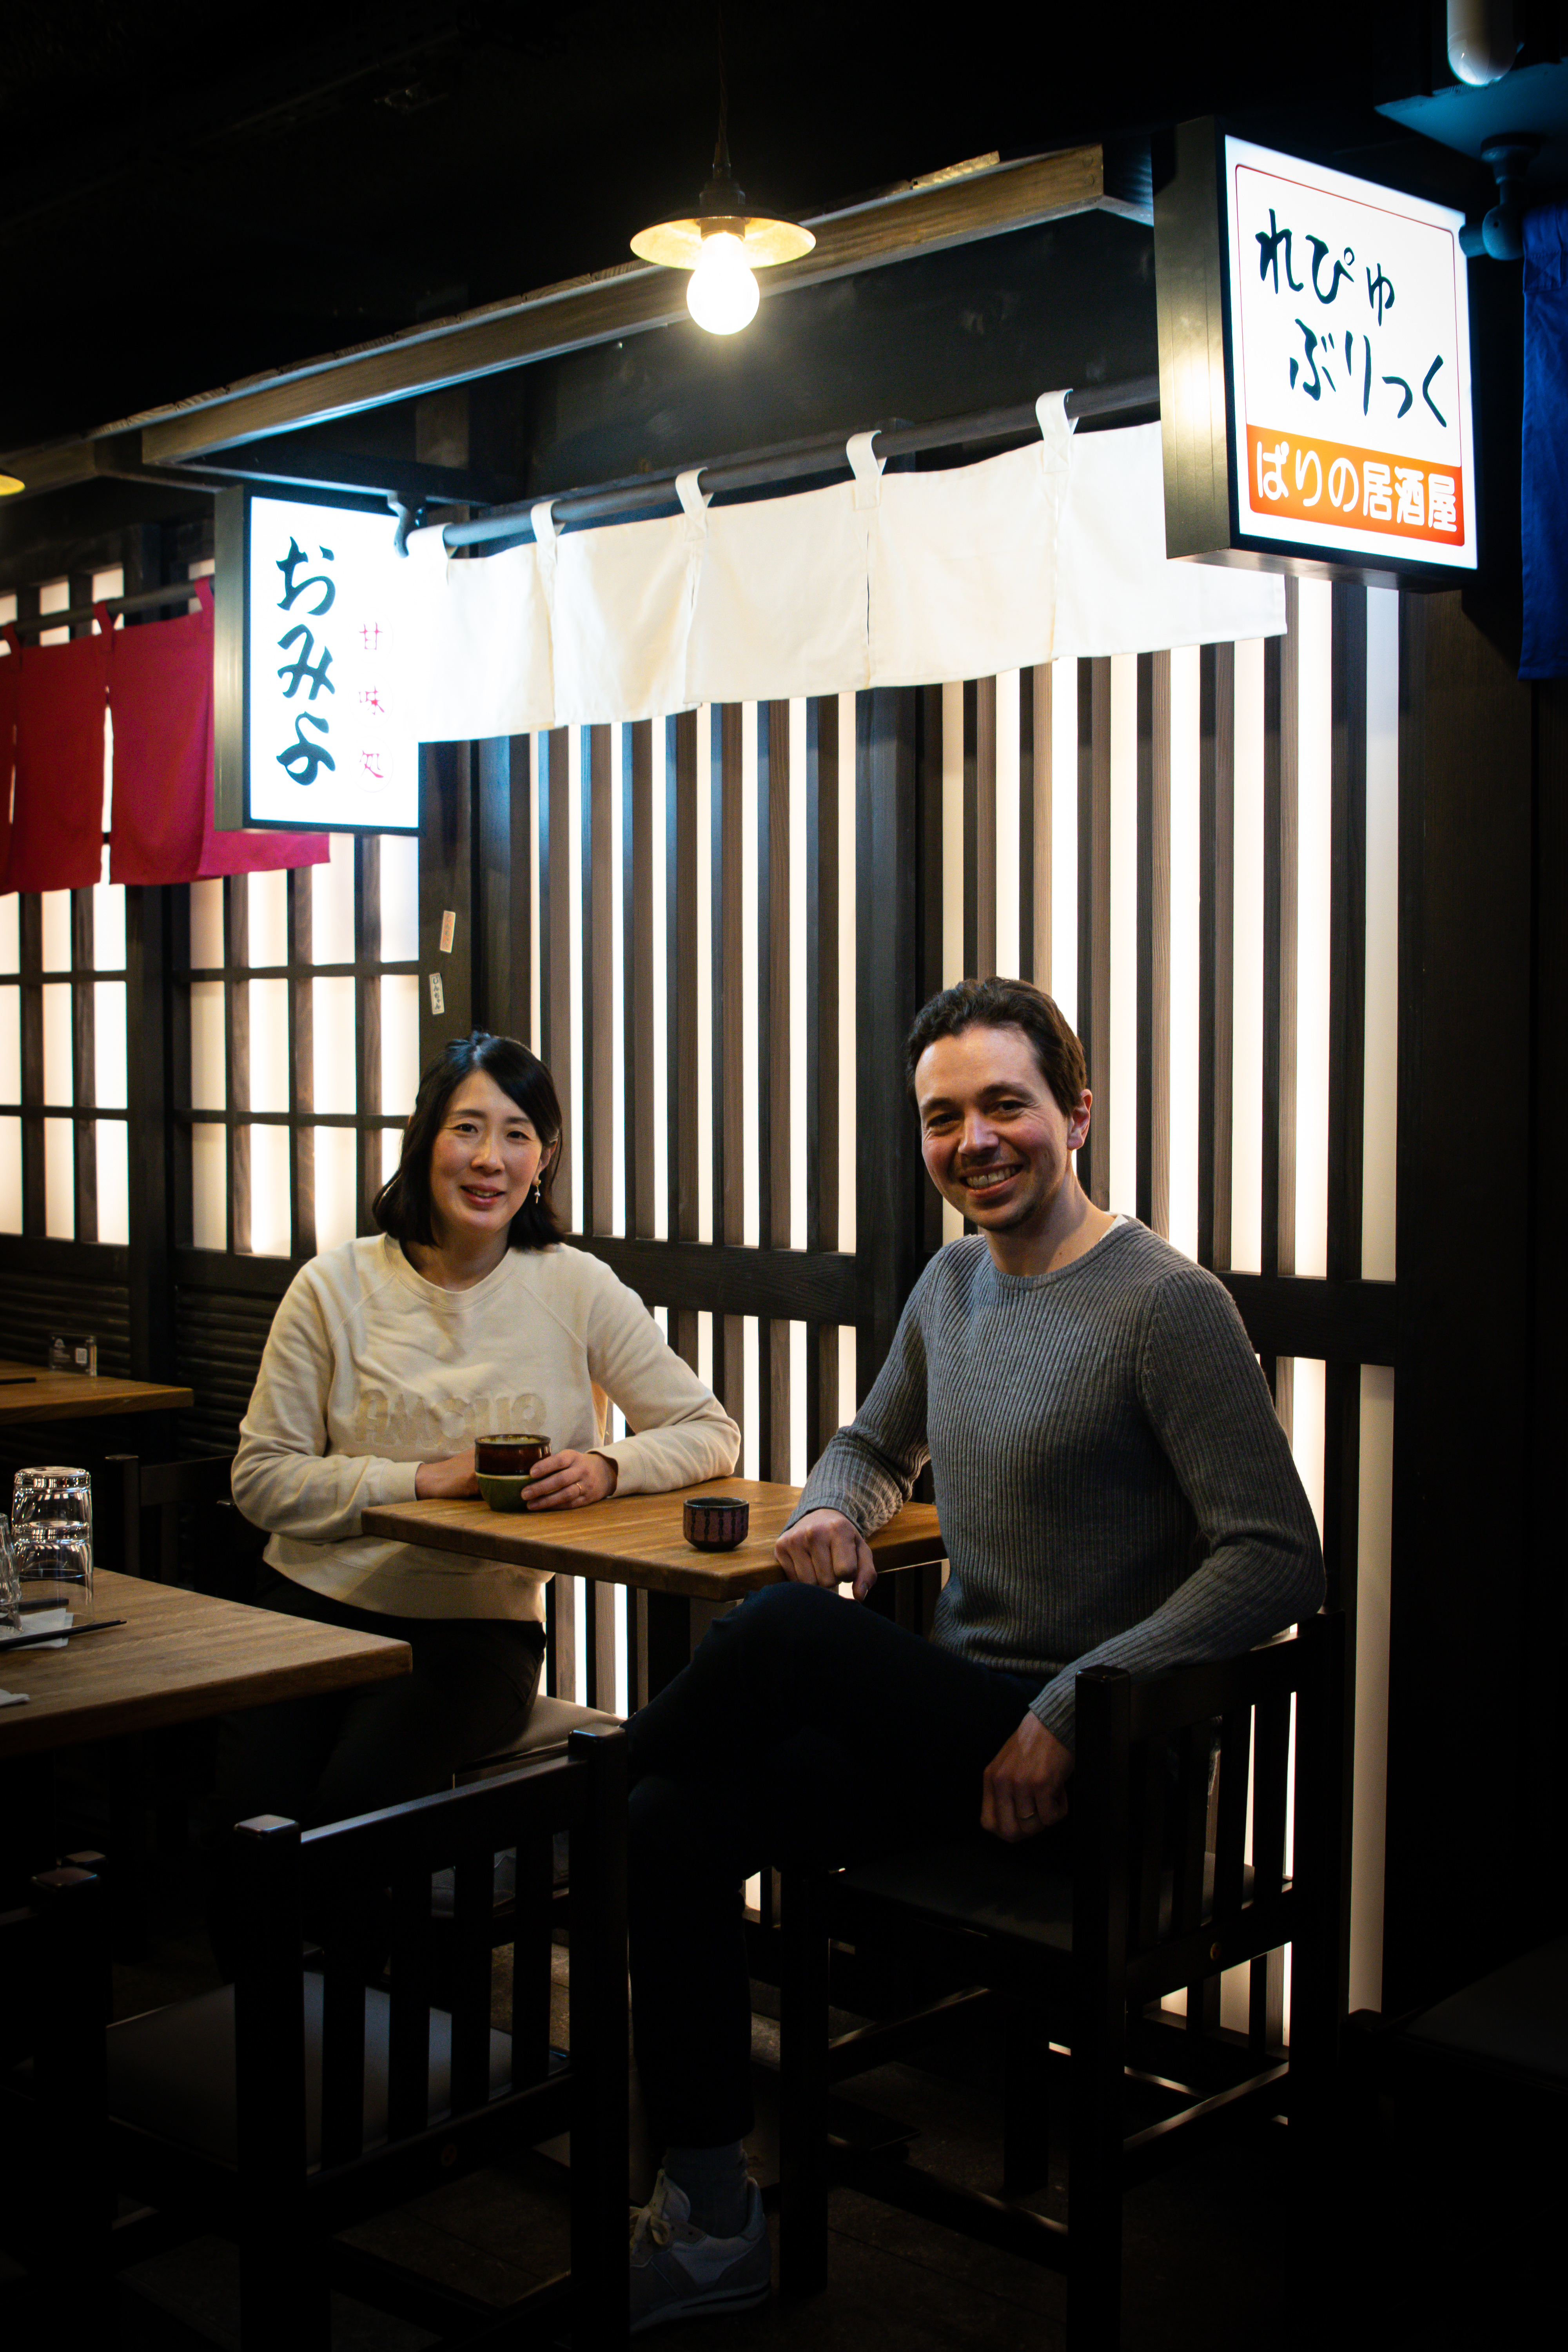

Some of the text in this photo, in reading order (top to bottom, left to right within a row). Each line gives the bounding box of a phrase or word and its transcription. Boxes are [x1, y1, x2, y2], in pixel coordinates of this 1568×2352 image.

[1255, 208, 1395, 327] れぴゅ
[1290, 318, 1447, 428] ぶりっく
[1256, 441, 1457, 532] ぱりの居酒屋
[358, 622, 385, 779] 甘味処
